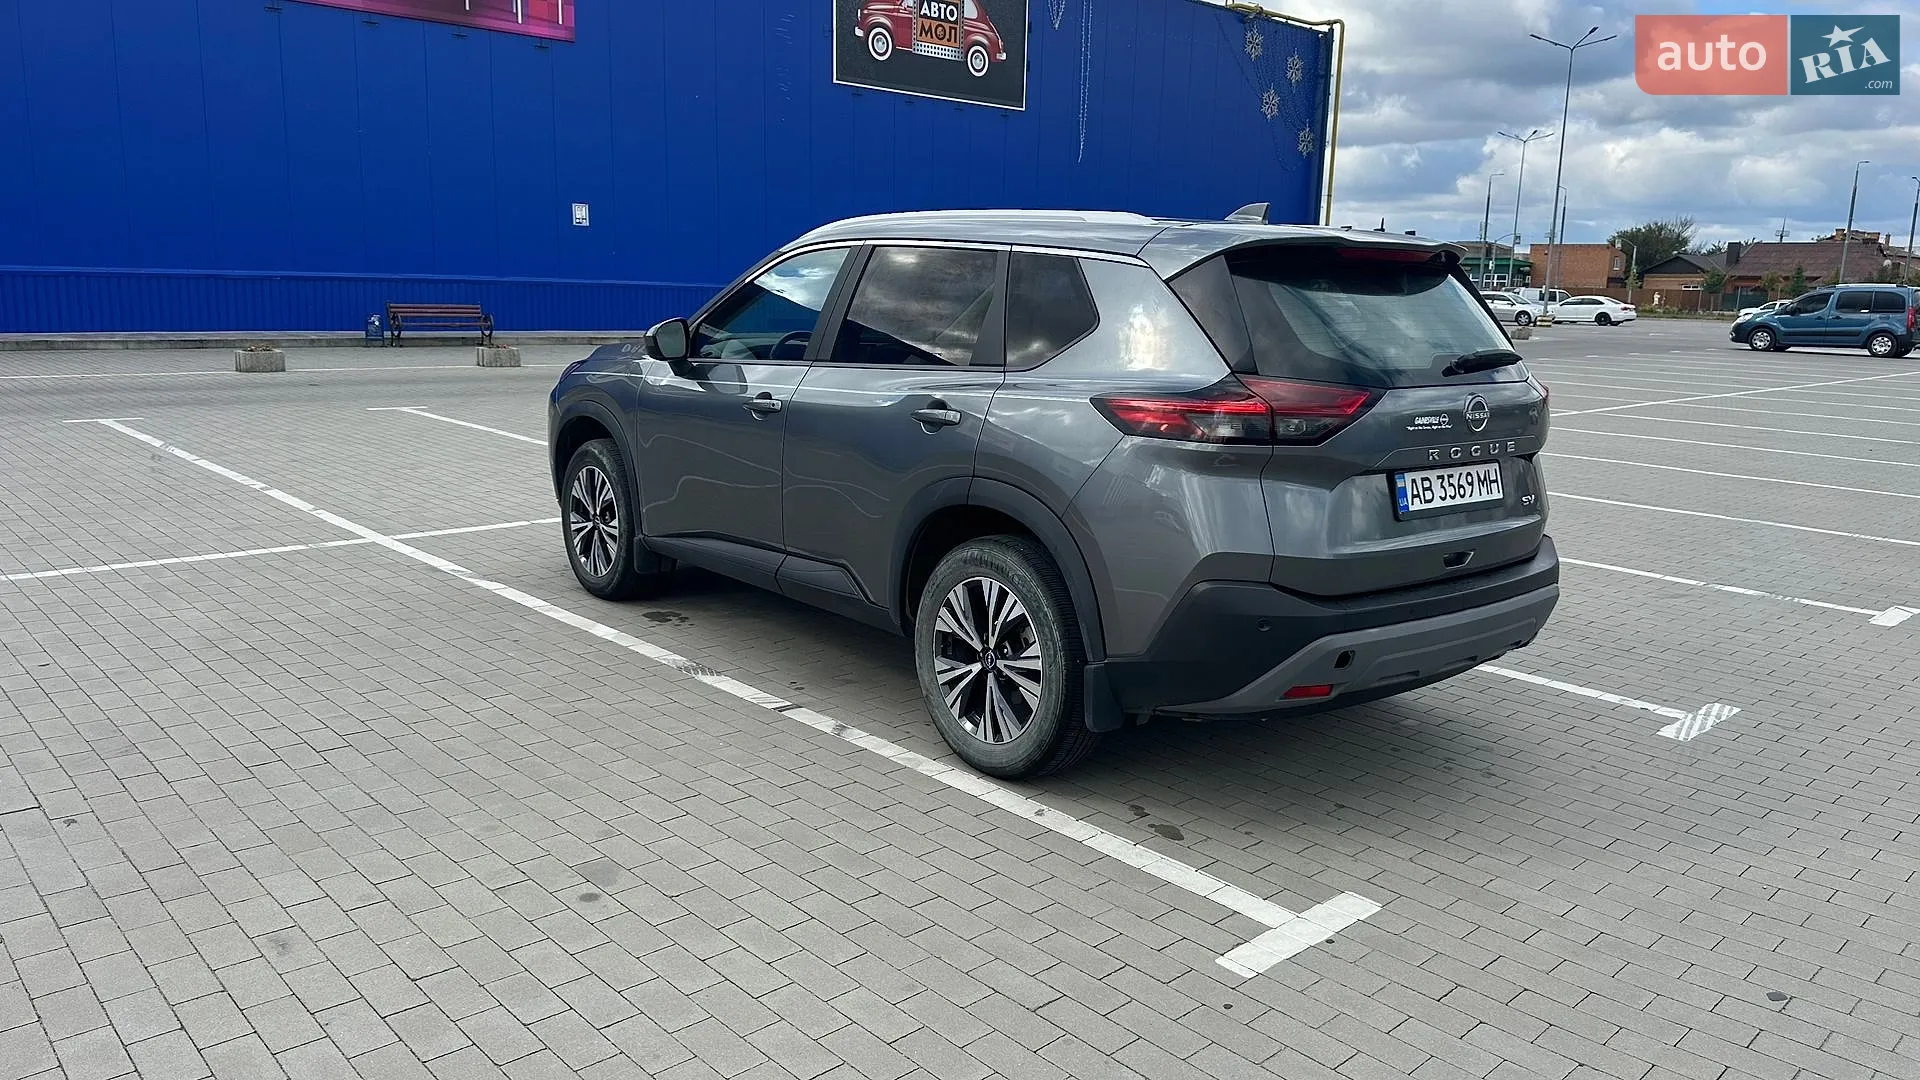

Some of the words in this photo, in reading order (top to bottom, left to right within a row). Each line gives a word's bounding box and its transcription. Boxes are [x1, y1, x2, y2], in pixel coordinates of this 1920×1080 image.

[920, 0, 958, 21] АВТО
[919, 20, 958, 43] МОЛ
[1428, 441, 1516, 461] ROGUE
[1411, 476, 1435, 506] AB
[1436, 471, 1474, 501] 3569
[1476, 467, 1501, 497] MH
[1521, 494, 1535, 506] SV
